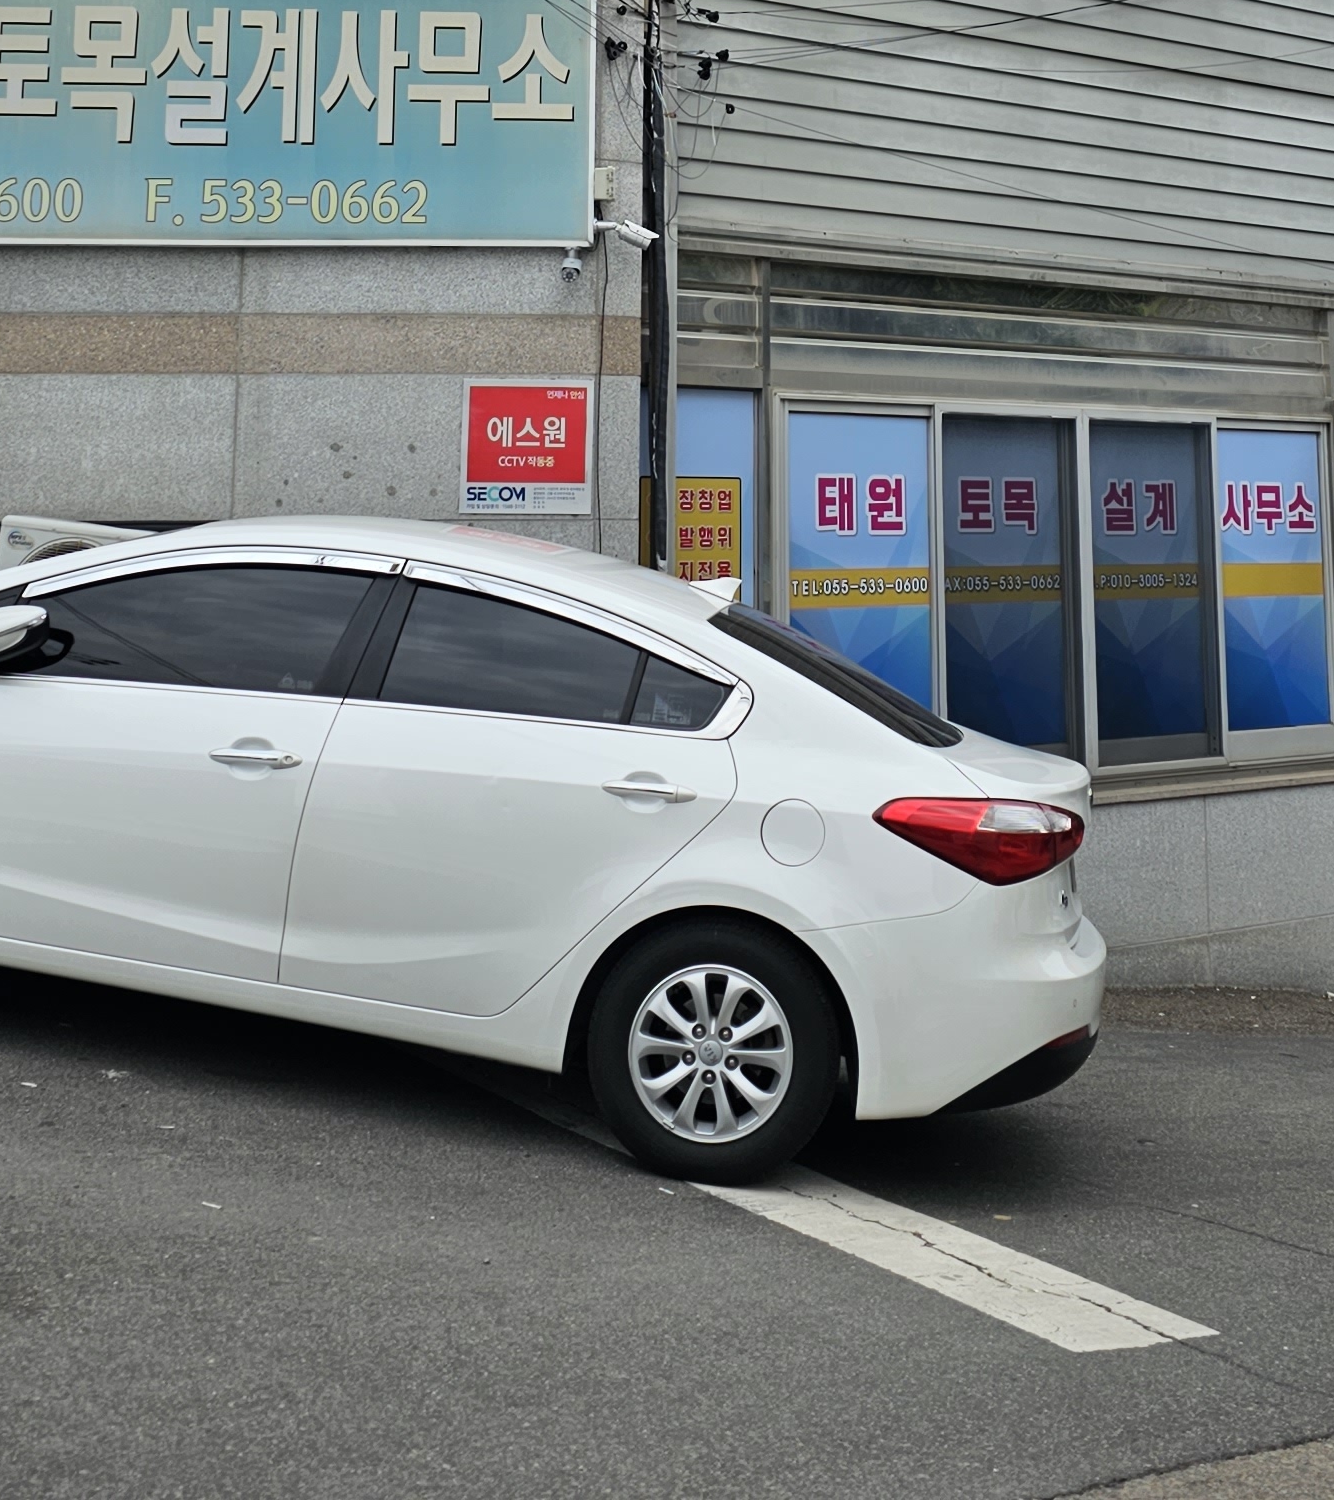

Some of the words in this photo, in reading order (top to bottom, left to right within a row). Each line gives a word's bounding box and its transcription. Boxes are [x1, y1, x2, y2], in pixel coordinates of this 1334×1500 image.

[145, 178, 184, 227] F.
[199, 178, 429, 228] 533-0662
[486, 416, 566, 449] 에스원
[498, 455, 527, 468] CCTV
[466, 485, 526, 502] SECOM
[815, 472, 908, 536] 태원
[957, 474, 1038, 536] 토목
[1101, 477, 1178, 535] 설계
[1220, 481, 1318, 535] 사무소
